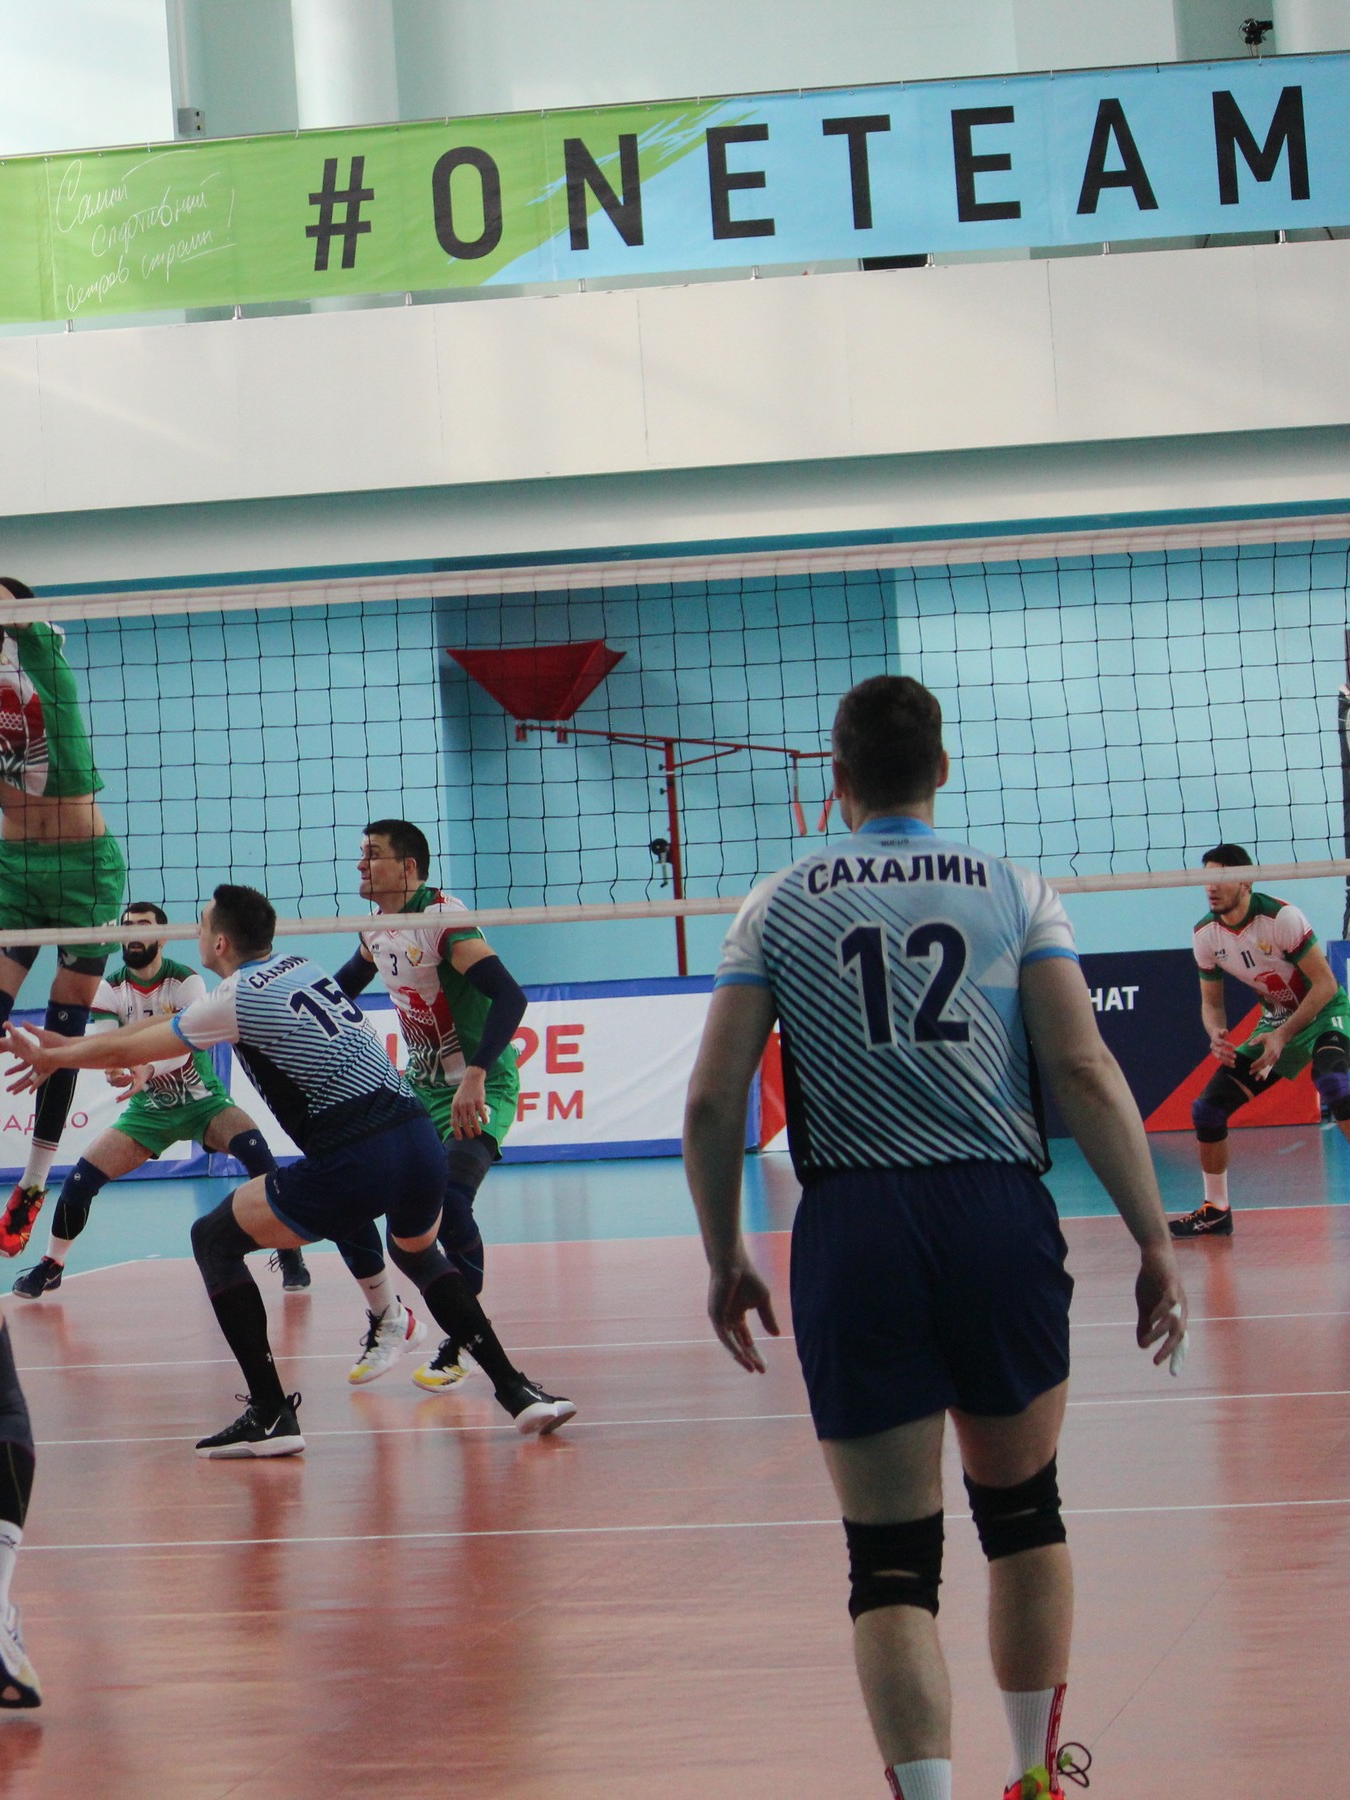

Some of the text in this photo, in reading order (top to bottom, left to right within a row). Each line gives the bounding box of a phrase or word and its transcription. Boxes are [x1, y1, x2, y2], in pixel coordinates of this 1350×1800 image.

[305, 84, 1310, 272] #ONETEAM
[807, 854, 988, 895] САХАЛИН
[389, 953, 398, 976] 3
[1240, 950, 1255, 968] 11
[840, 922, 971, 1046] 12
[290, 977, 364, 1038] 15
[517, 1090, 583, 1121] FM
